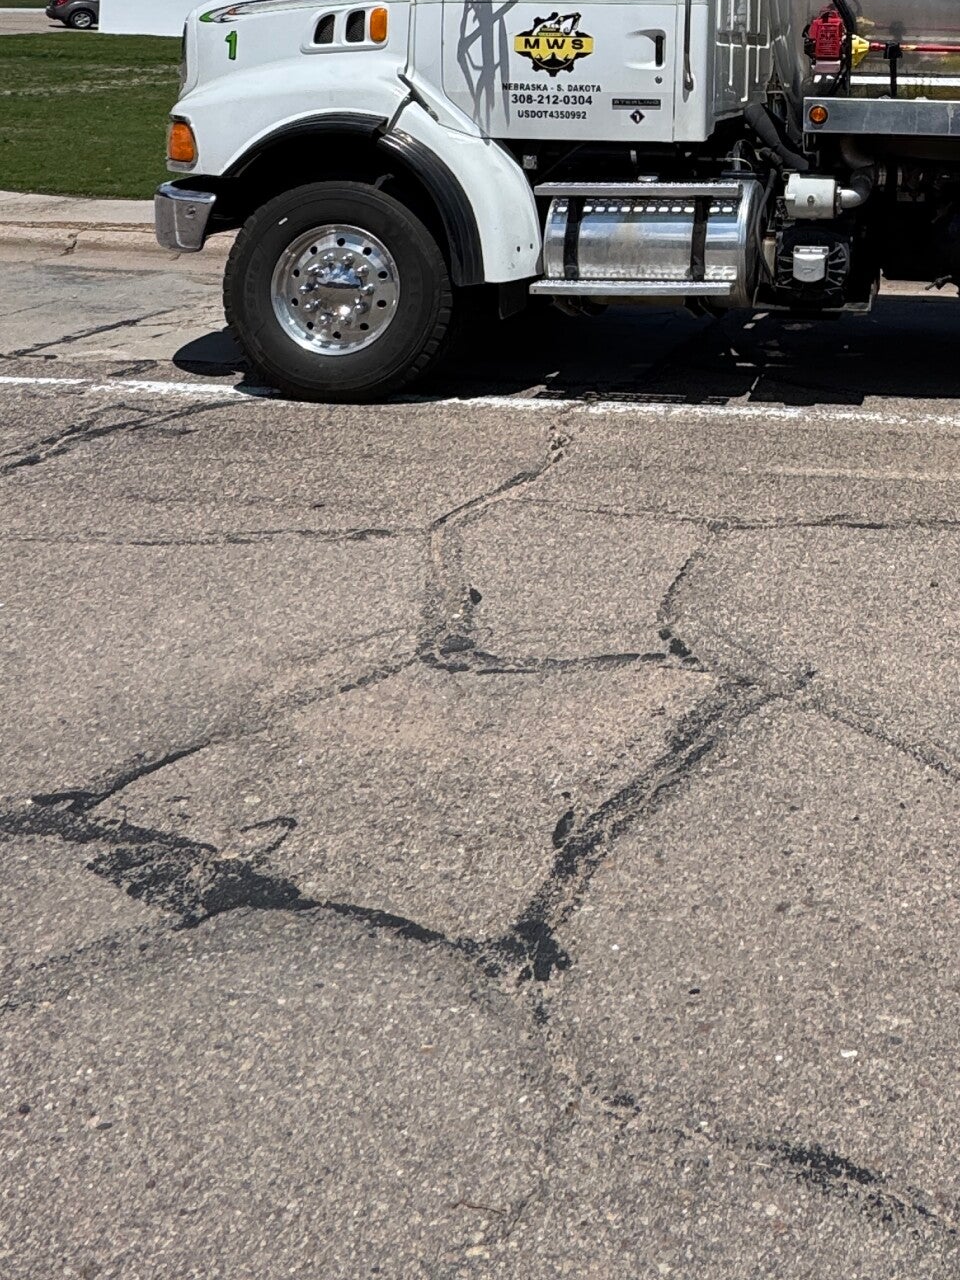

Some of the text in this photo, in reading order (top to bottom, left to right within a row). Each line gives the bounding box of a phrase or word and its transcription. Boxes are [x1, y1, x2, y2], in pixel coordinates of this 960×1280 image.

[225, 30, 238, 60] 1
[501, 83, 548, 92] NEBRASKA
[567, 84, 602, 93] DAKOTA
[511, 93, 593, 106] 308-212-0304
[517, 109, 587, 120] USDOT4350992
